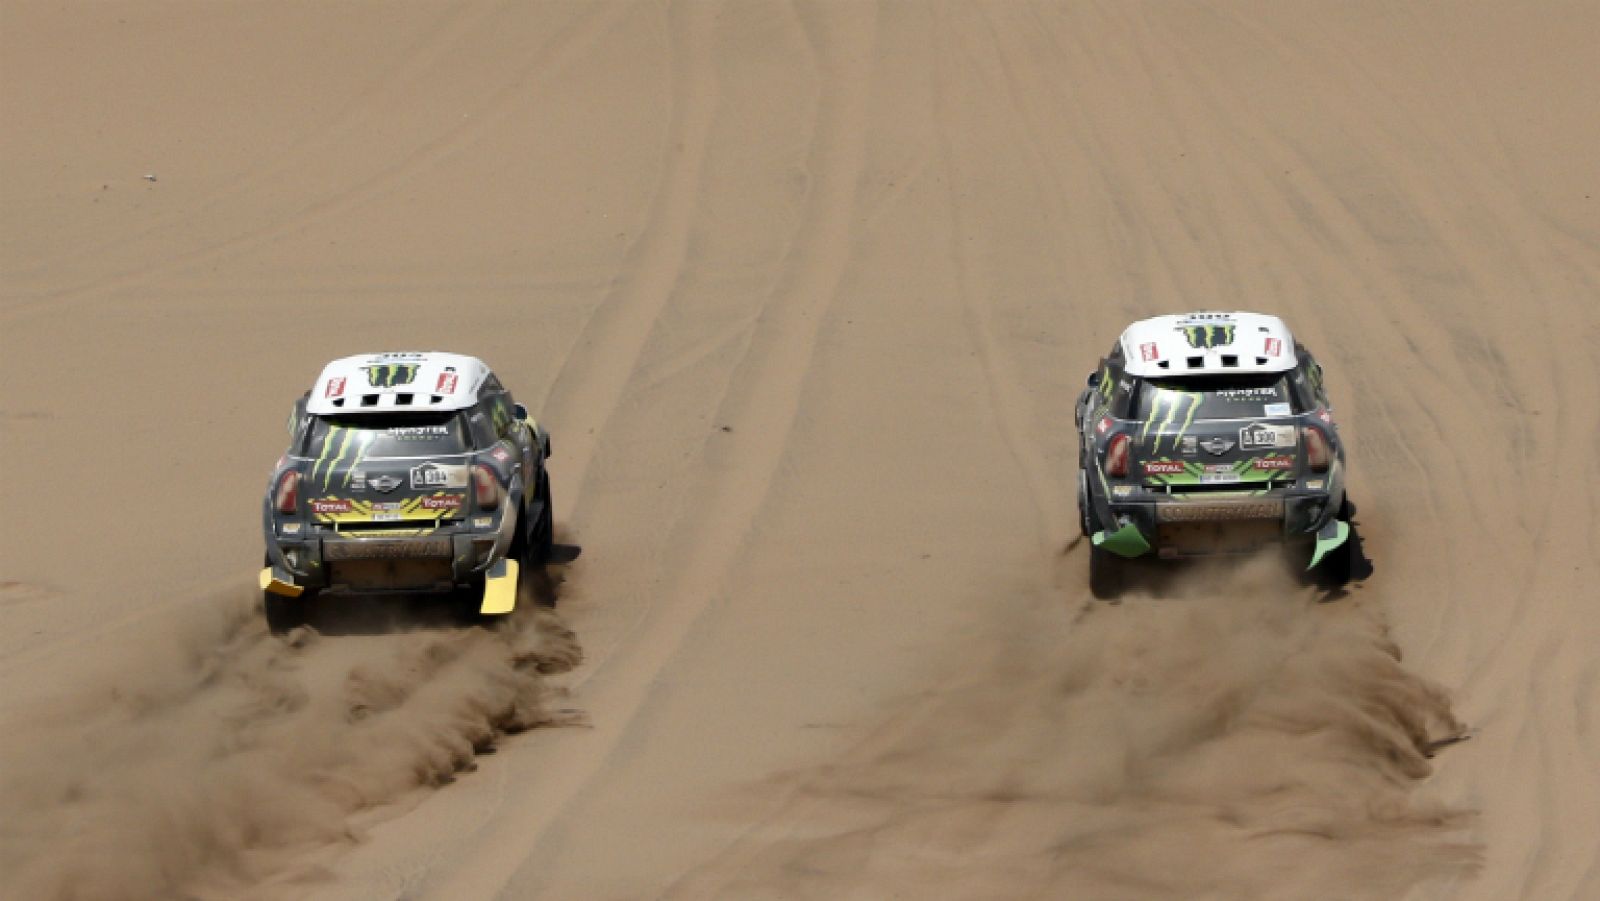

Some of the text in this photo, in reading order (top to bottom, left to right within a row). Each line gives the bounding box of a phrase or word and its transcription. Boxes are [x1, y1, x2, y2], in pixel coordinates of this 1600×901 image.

[1146, 464, 1182, 472] TOTAL
[1256, 459, 1290, 468] TOTAL
[315, 503, 348, 512] TOTAL
[424, 498, 460, 508] TOTAL
